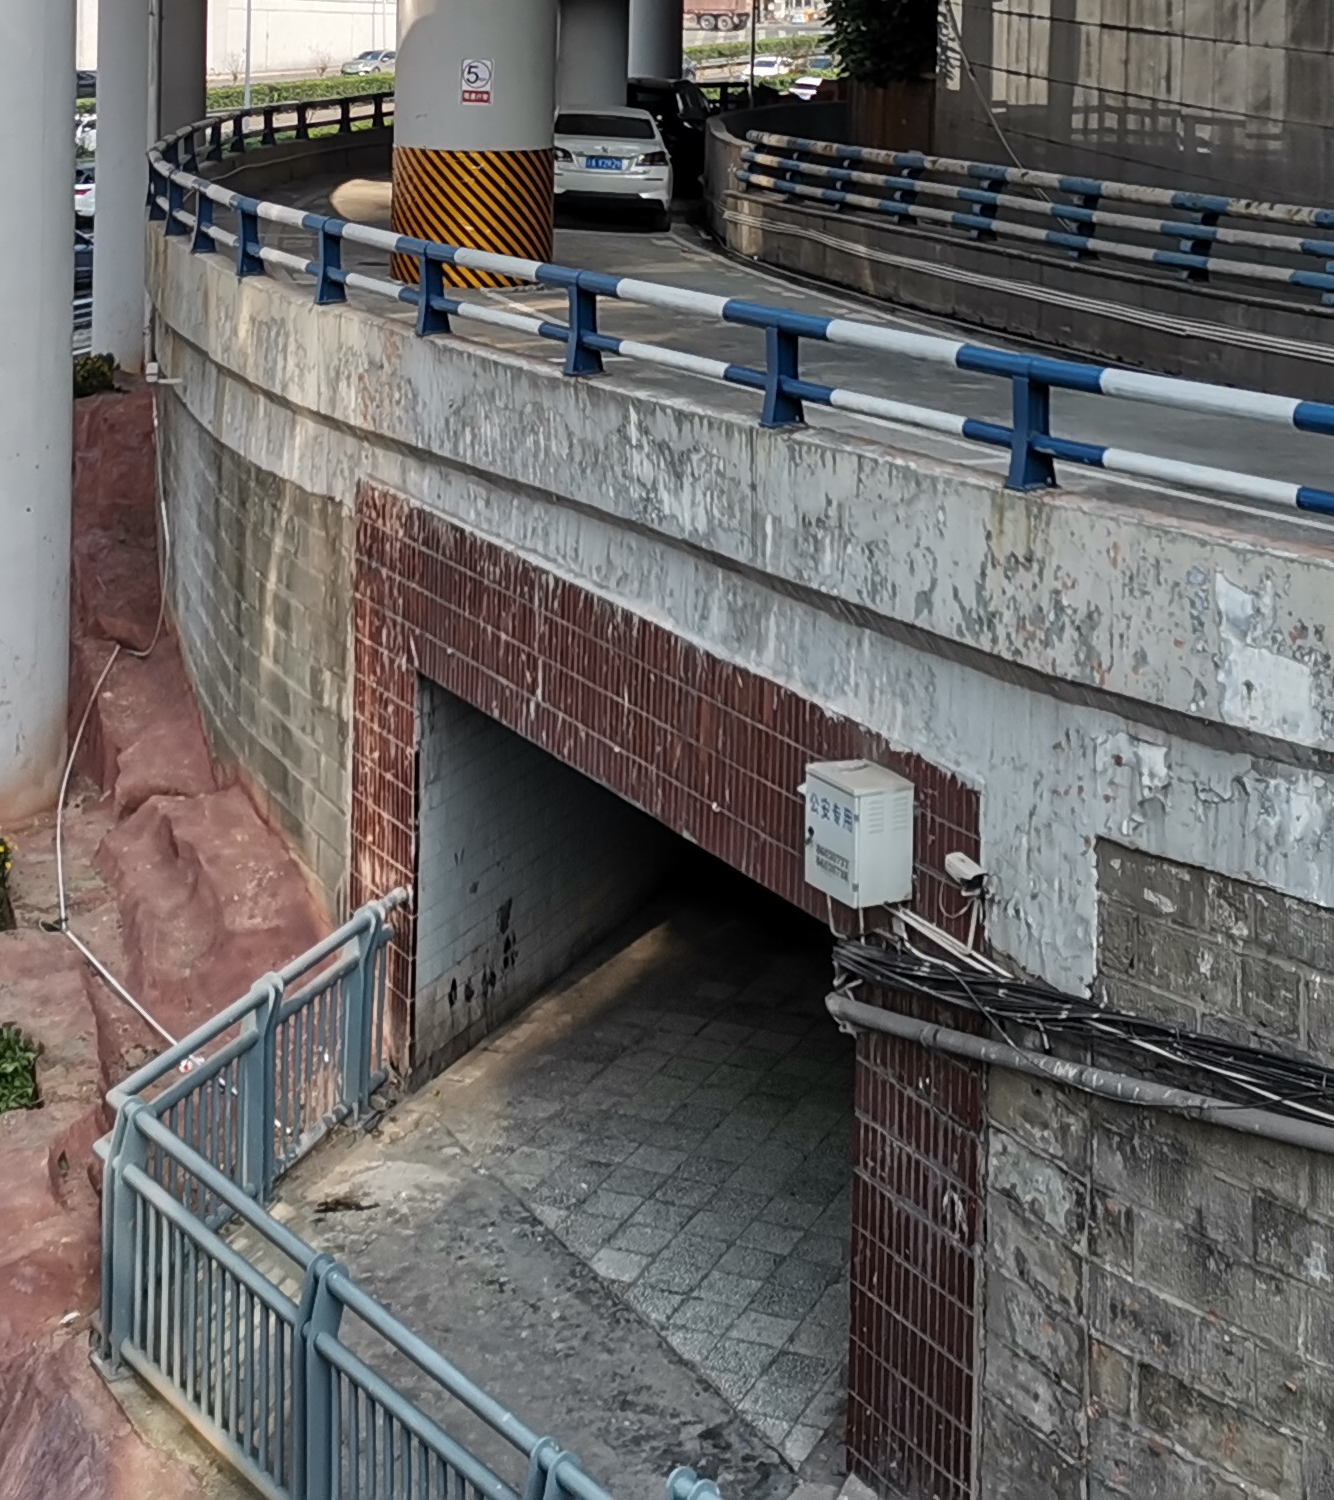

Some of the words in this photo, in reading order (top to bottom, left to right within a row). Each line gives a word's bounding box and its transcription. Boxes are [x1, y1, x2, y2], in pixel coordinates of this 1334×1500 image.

[467, 65, 479, 84] 5
[809, 792, 853, 833] 公安专用
